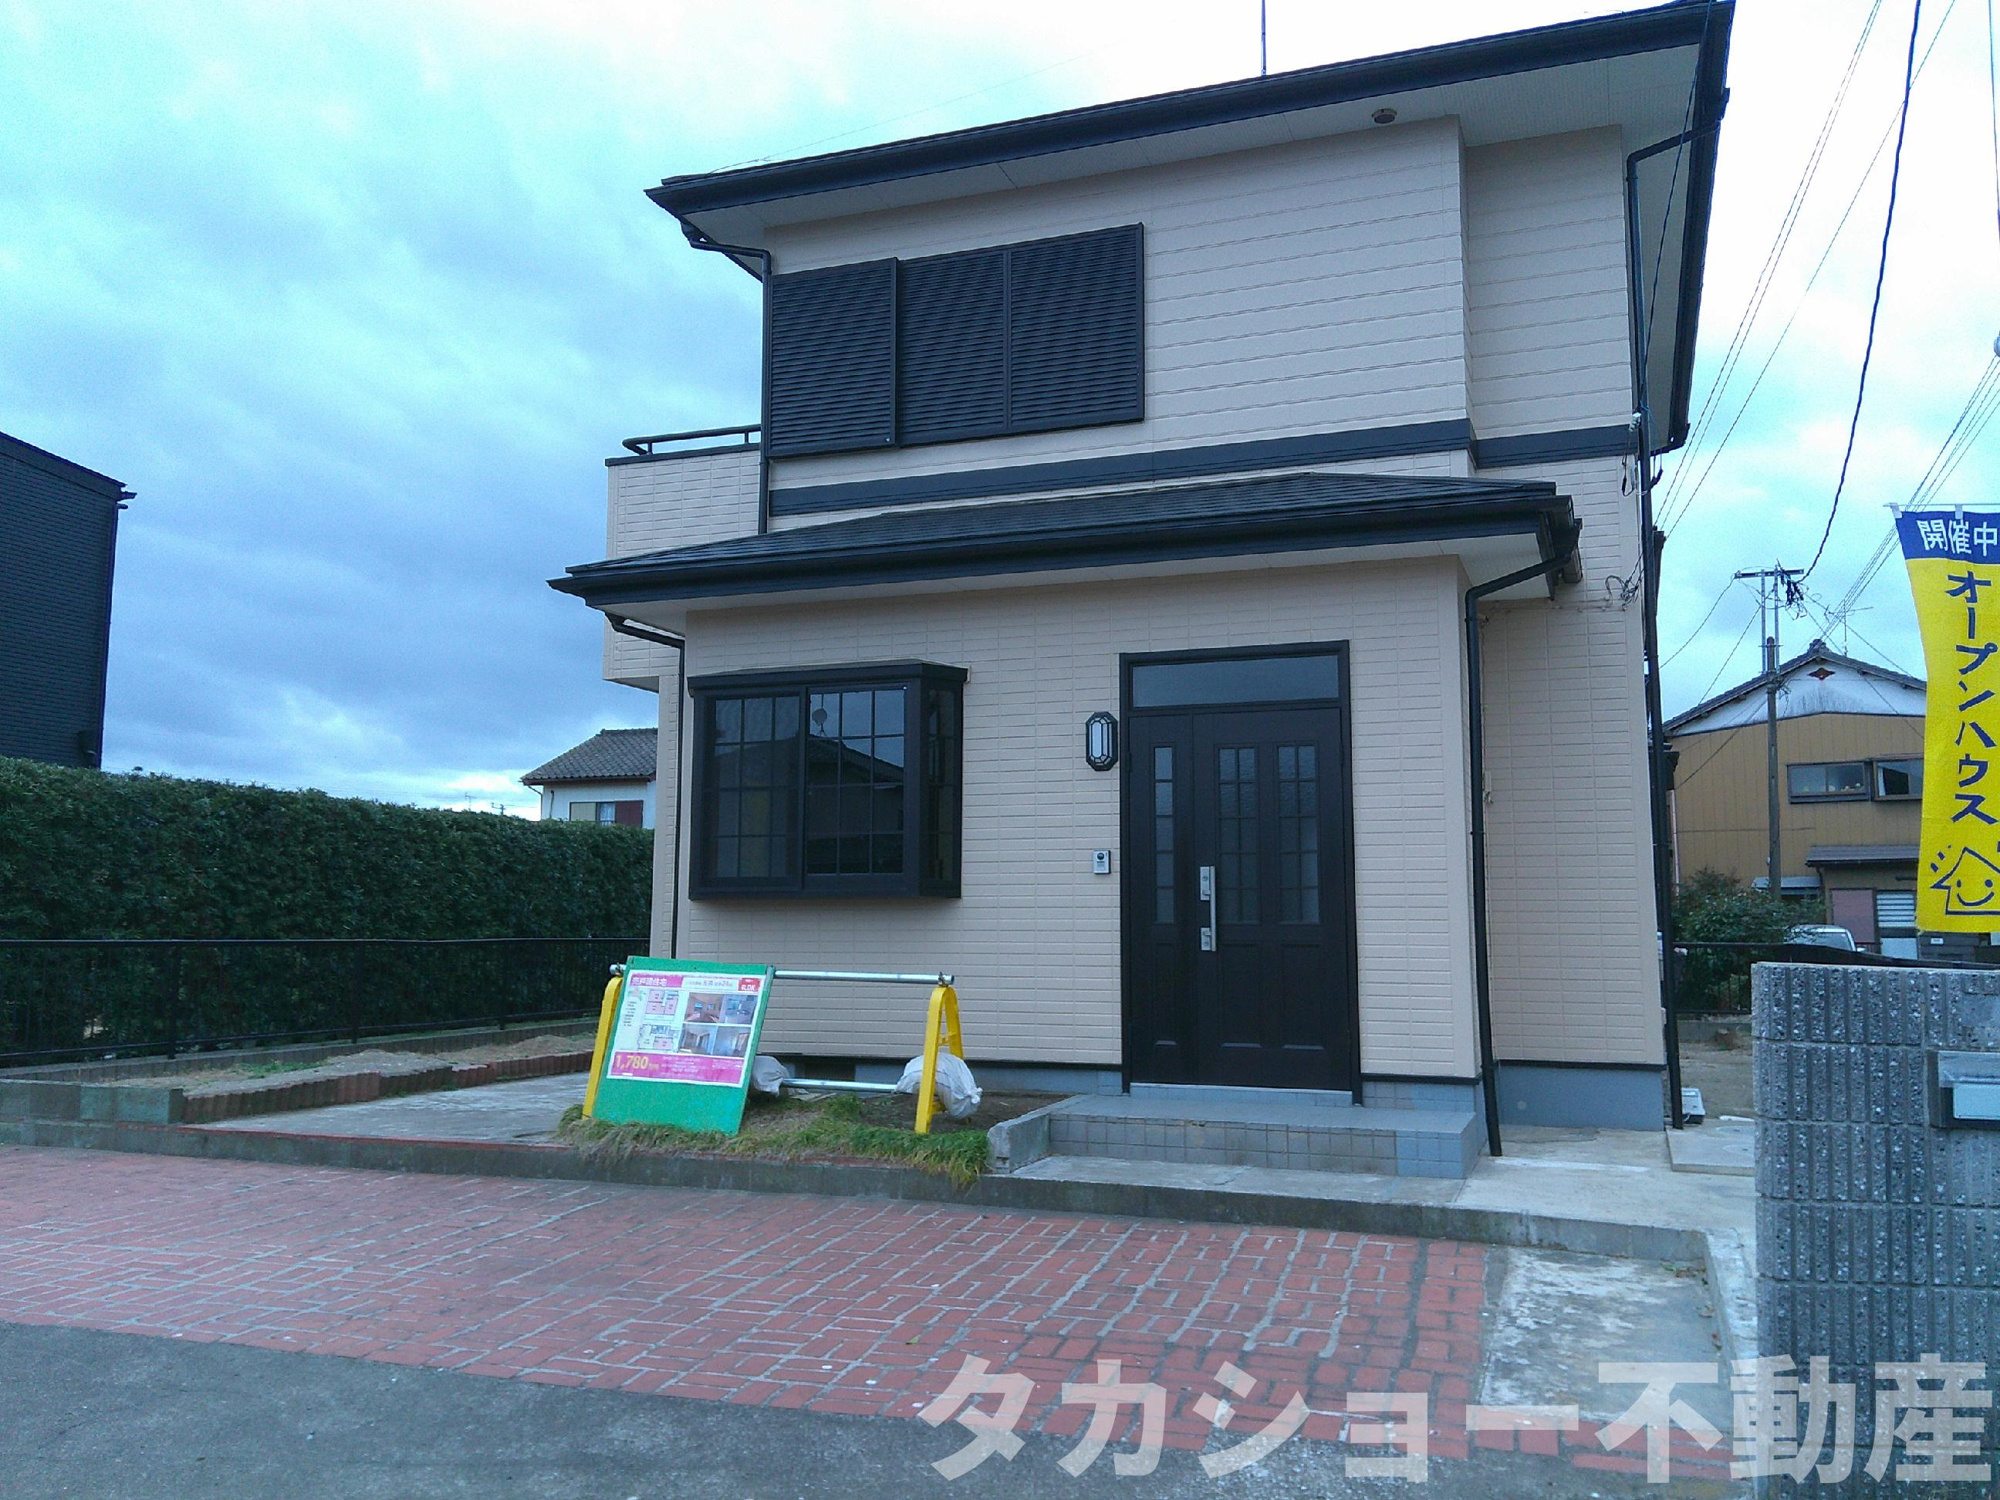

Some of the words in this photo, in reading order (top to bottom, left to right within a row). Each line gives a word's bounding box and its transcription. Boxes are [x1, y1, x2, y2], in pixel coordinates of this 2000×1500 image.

[1916, 519, 1998, 557] 開催中
[1945, 570, 1998, 826] オープンハウス
